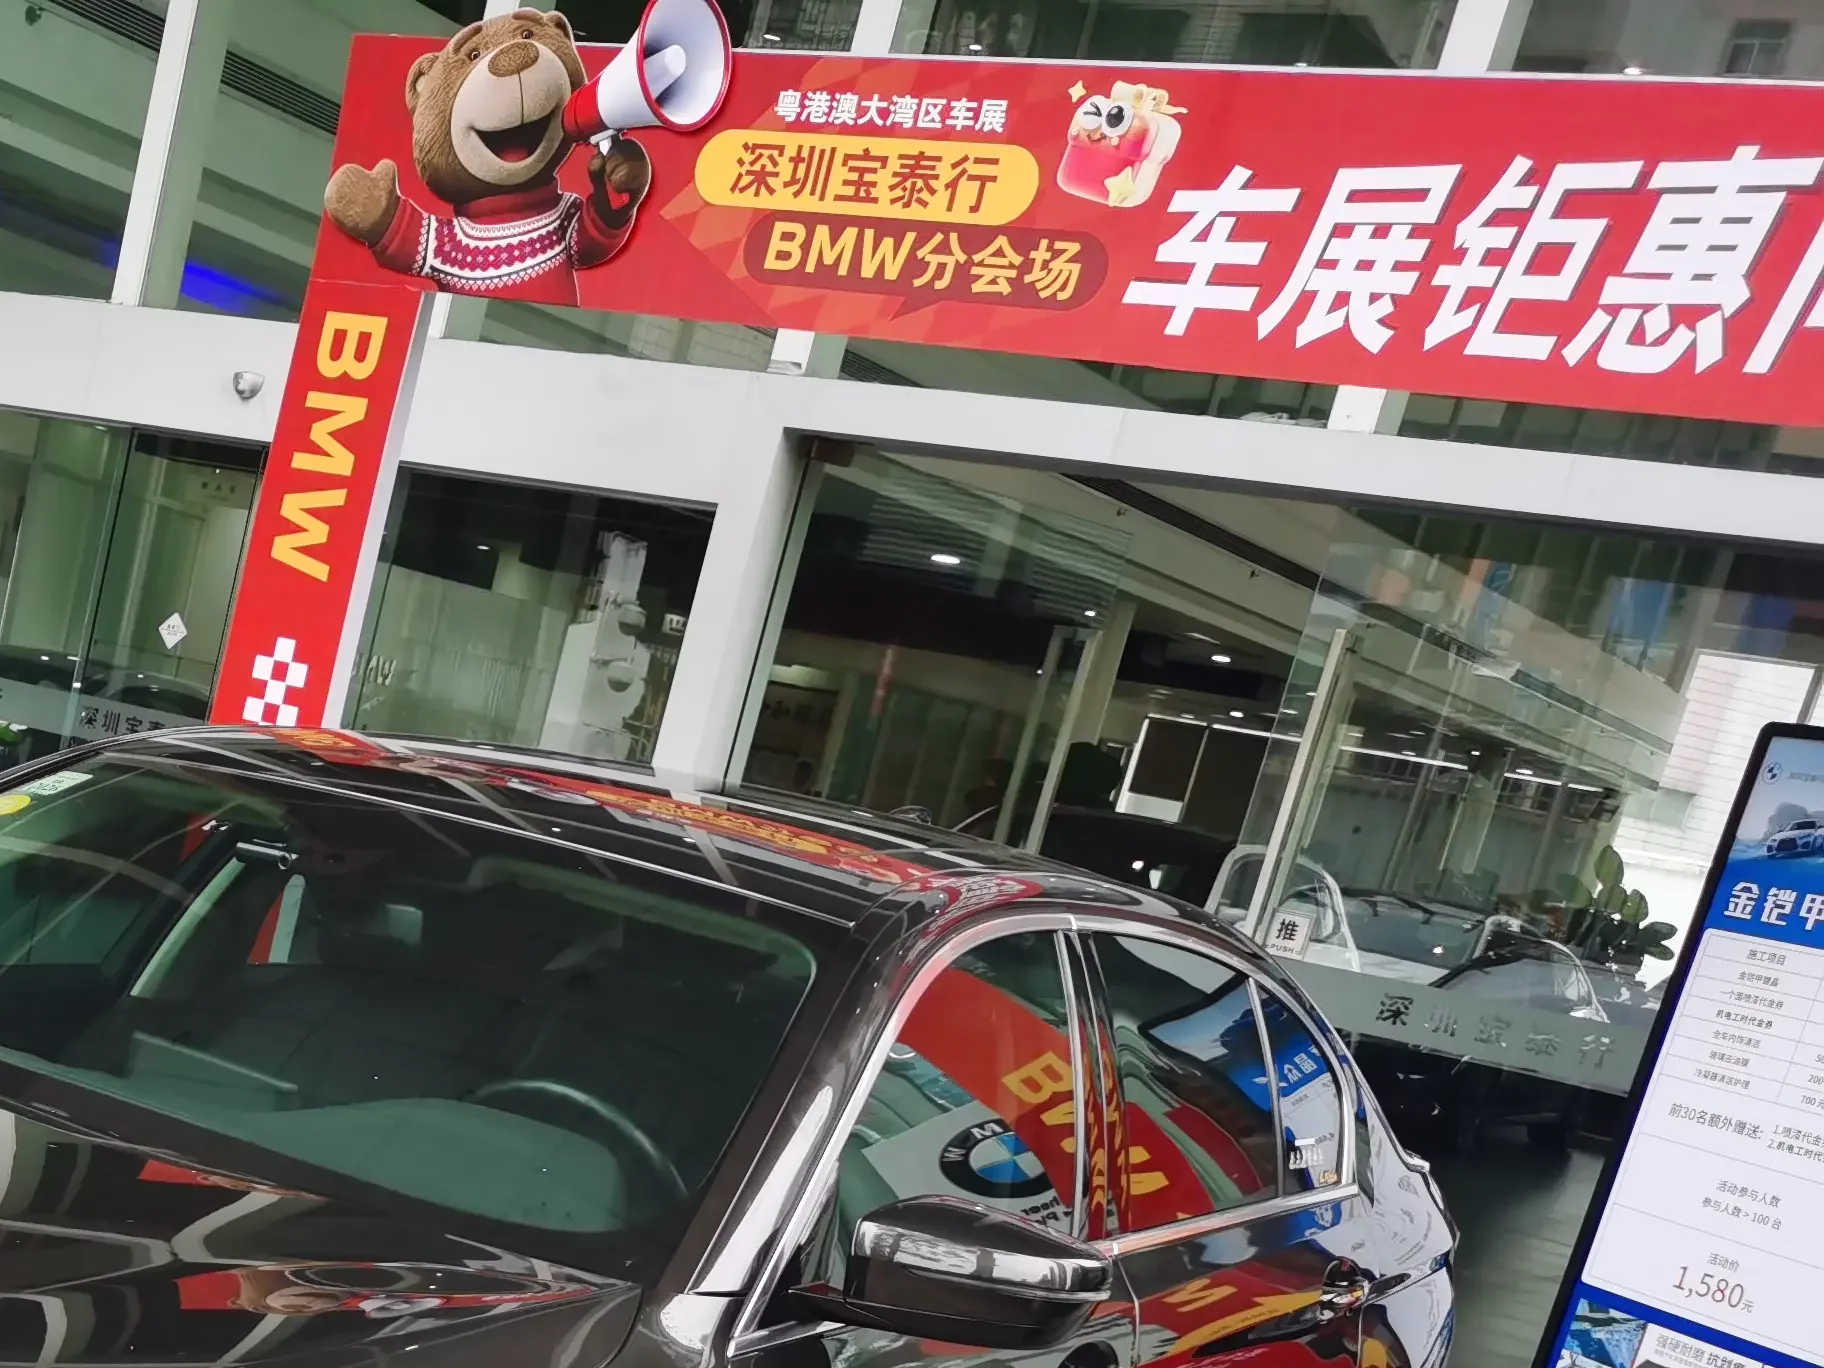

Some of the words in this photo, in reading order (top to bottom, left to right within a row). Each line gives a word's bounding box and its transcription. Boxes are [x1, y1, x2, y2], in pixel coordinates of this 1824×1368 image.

[774, 89, 1008, 133] 粤港澳大湾区车展
[729, 142, 1000, 214] 深圳宝泰行
[764, 221, 1082, 300] BMW分会场
[1122, 146, 1824, 375] 车展钜惠
[271, 312, 387, 583] BMW
[1275, 918, 1299, 941] 推
[1270, 943, 1294, 954] PUSH
[1745, 949, 1787, 966] 施工项目
[1772, 1124, 1824, 1148] 1.喷漆代金
[1766, 1138, 1824, 1163] 2.机电工时代
[1715, 1178, 1782, 1209] 活动参与人数
[1706, 1252, 1740, 1274] 活动价
